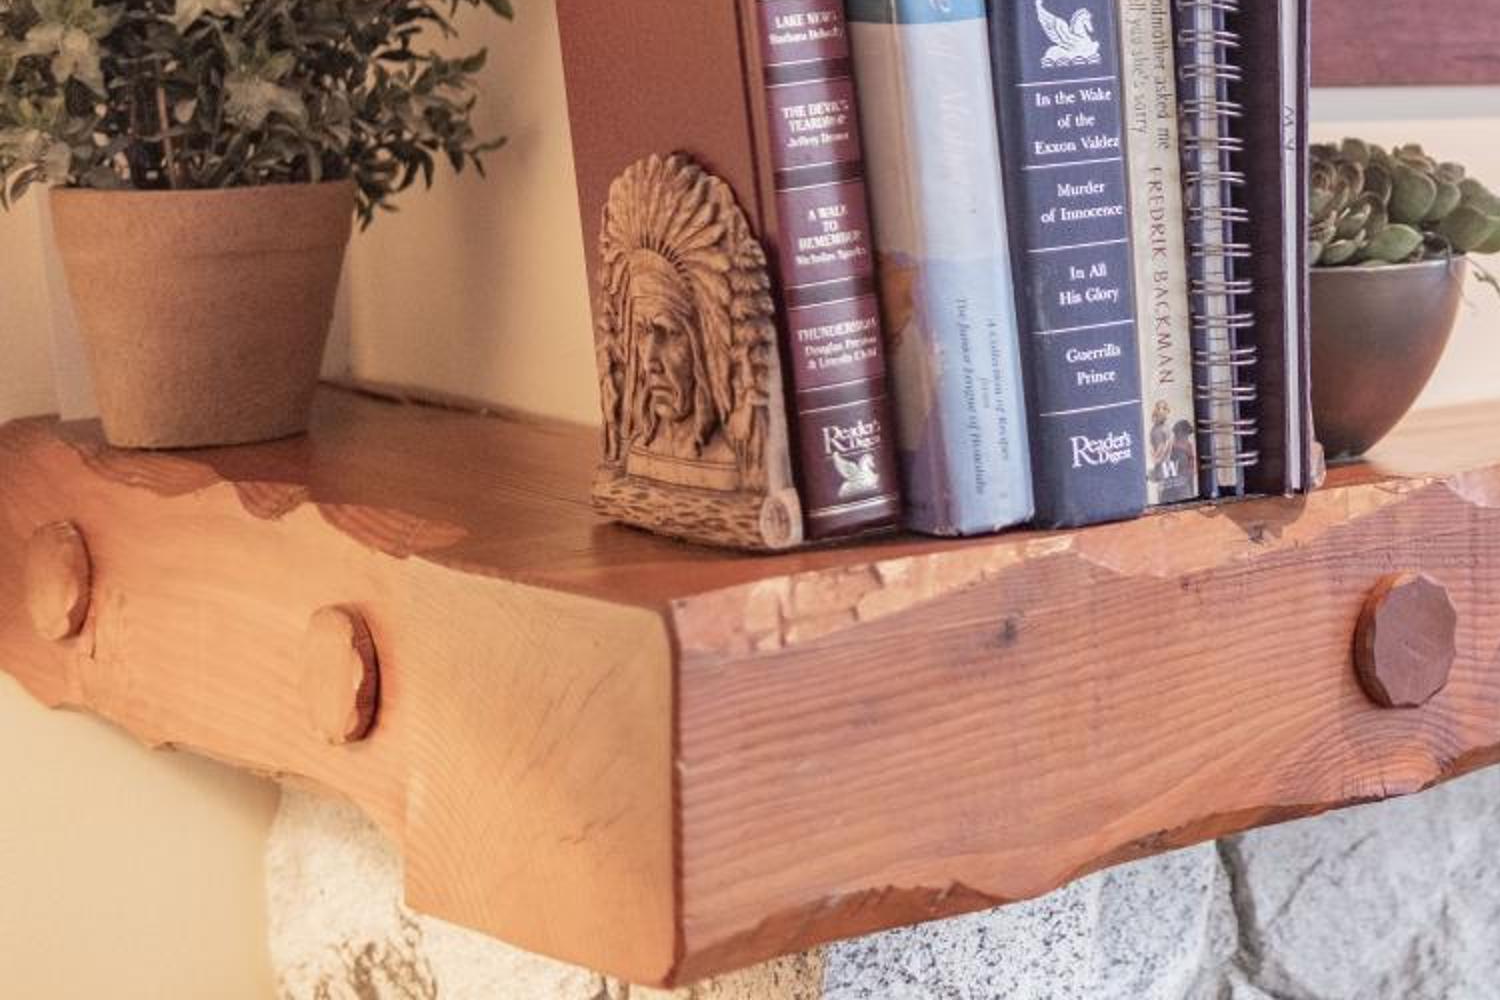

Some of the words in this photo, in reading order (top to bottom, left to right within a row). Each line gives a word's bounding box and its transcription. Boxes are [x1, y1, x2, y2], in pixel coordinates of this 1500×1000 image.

[1035, 93, 1050, 107] In
[1055, 90, 1076, 105] the
[1079, 88, 1112, 102] Wake
[1155, 77, 1174, 119] asked
[782, 105, 806, 119] THE
[1057, 113, 1073, 129] of
[1075, 112, 1096, 127] the
[1034, 141, 1077, 155] Exxon
[1080, 135, 1121, 150] Valdez
[1157, 126, 1169, 149] me
[1057, 180, 1105, 197] Murder
[1041, 208, 1057, 224] of
[1060, 204, 1124, 221] Innocence
[1147, 167, 1168, 259] FREDRIK
[822, 220, 839, 233] TO
[1069, 266, 1085, 280] In
[1088, 262, 1107, 278] All
[1059, 291, 1083, 306] His
[1085, 286, 1119, 303] Glory
[1152, 269, 1175, 384] BACKMAN
[1066, 343, 1122, 363] Guerrilla
[1076, 370, 1117, 386] Prince
[1069, 431, 1132, 468] Reader's
[1096, 448, 1132, 466] Digest
[1162, 460, 1179, 478] W
